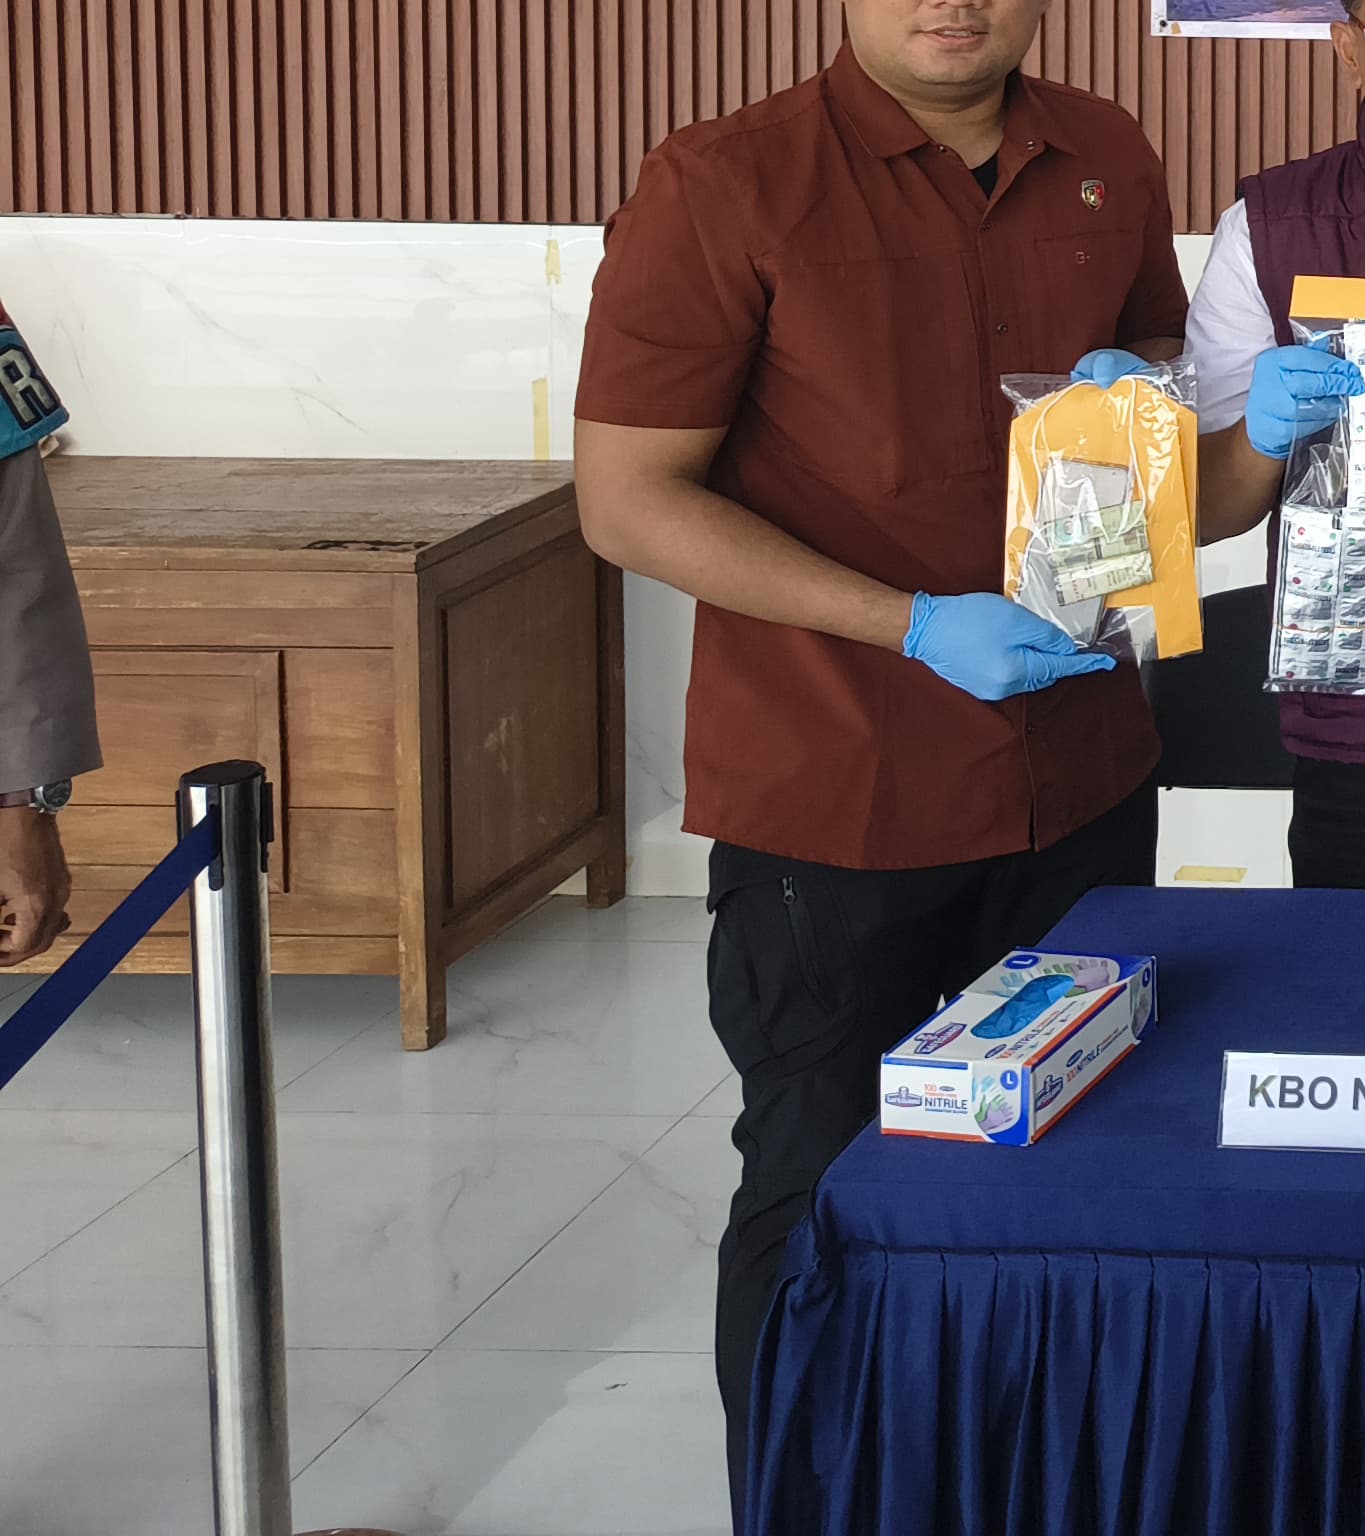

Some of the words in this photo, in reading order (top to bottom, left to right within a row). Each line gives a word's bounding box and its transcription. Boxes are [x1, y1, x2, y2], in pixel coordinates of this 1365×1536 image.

[1006, 1072, 1014, 1085] L
[1248, 1074, 1338, 1111] KBO
[924, 1096, 968, 1110] NITRILE
